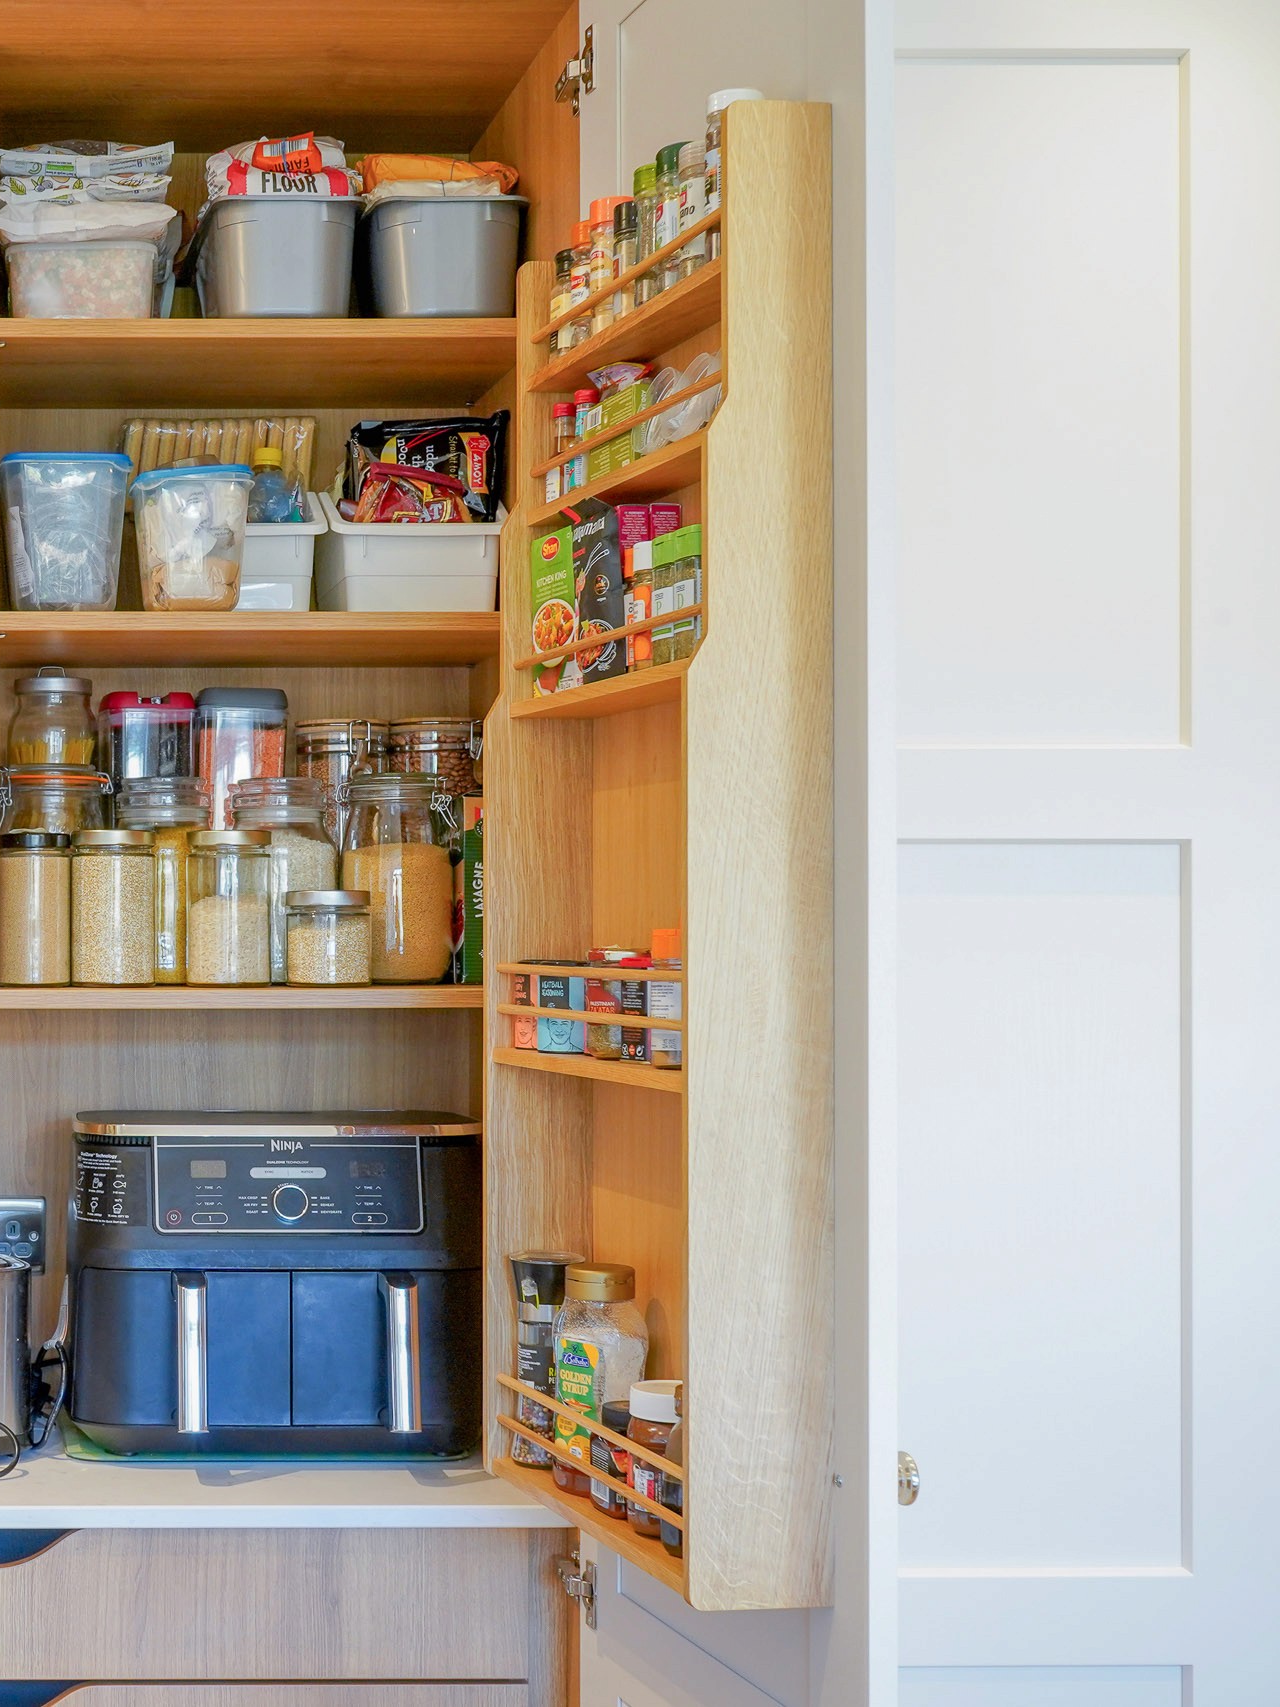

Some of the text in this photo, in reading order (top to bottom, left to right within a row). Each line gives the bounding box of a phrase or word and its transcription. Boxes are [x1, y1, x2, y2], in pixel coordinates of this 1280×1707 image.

[262, 172, 318, 193] FLOUR
[472, 453, 482, 485] AMOY
[543, 542, 558, 557] Shan
[536, 570, 567, 588] KITCHEN KING
[270, 1139, 303, 1153] NINJA
[560, 1369, 592, 1385] GOLDEN
[562, 1382, 589, 1396] SYRUP
